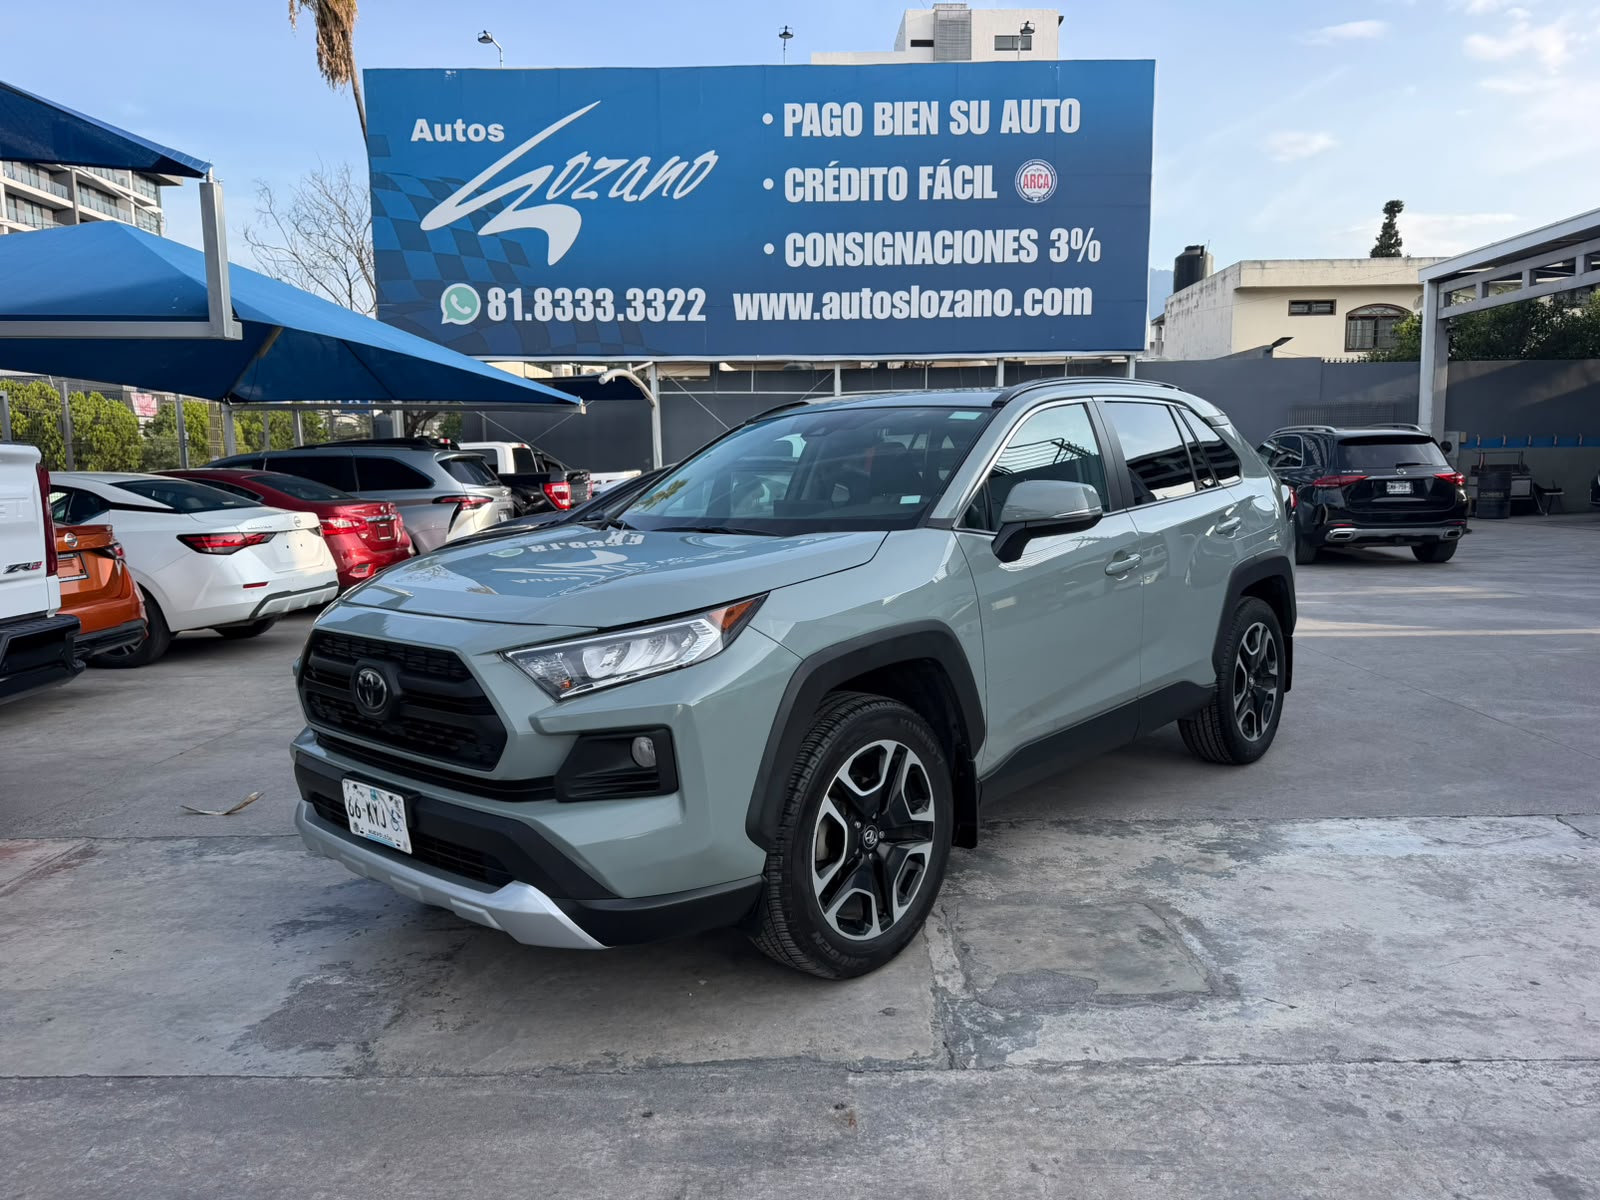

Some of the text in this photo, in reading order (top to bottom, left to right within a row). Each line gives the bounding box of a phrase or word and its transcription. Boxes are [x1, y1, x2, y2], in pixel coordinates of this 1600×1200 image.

[410, 118, 505, 142] Autos
[784, 98, 1081, 138] PAGO BIEN SU AUTO
[420, 100, 719, 266] Lozano
[784, 158, 998, 203] CRÉDITO FÁCIL
[1022, 173, 1050, 190] ARCA
[785, 227, 1101, 268] CONSIGNACIONES 3%
[487, 287, 706, 322] 81.8333.3322
[732, 285, 1093, 321] www.autoslozano.com
